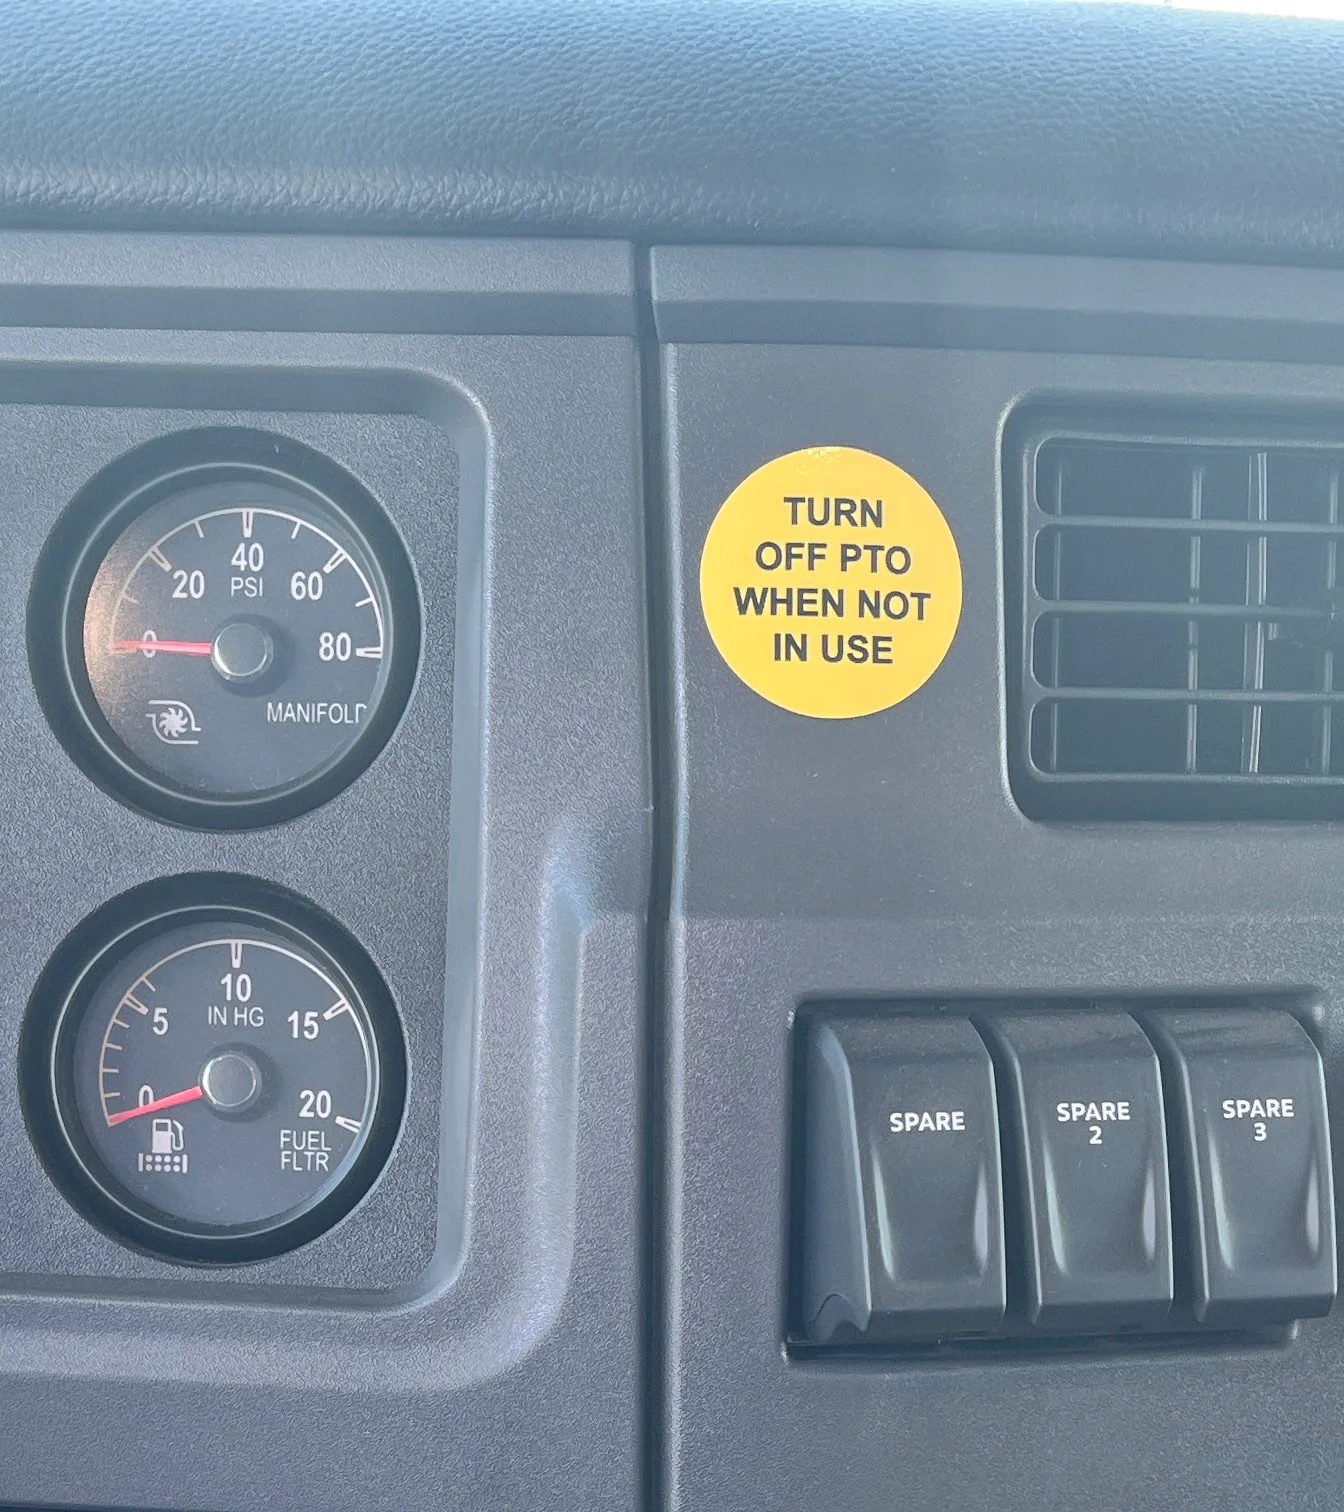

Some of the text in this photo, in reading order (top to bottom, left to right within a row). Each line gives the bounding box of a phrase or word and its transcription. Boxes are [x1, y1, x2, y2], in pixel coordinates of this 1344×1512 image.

[784, 496, 883, 528] TURN
[231, 542, 264, 572] 40
[756, 541, 912, 575] OFF PTO
[172, 570, 205, 599] 20
[230, 577, 264, 598] PSI
[290, 571, 323, 600] 60
[733, 587, 932, 621] WHEN NOT
[142, 630, 158, 659] 0
[318, 632, 352, 662] 80
[774, 633, 893, 665] IN USE
[221, 973, 252, 1002] 10
[152, 1008, 169, 1035] 5
[208, 1006, 265, 1028] IN HG
[287, 1011, 319, 1039] 15
[138, 1084, 154, 1109] 0
[298, 1090, 331, 1118] 20
[1222, 1098, 1295, 1119] SPARE
[889, 1111, 966, 1133] SPARE
[1056, 1101, 1131, 1122] SPARE
[280, 1129, 331, 1151] FUEL
[1089, 1125, 1103, 1145] 2
[1253, 1122, 1267, 1142] 3
[281, 1151, 330, 1172] FLTR
